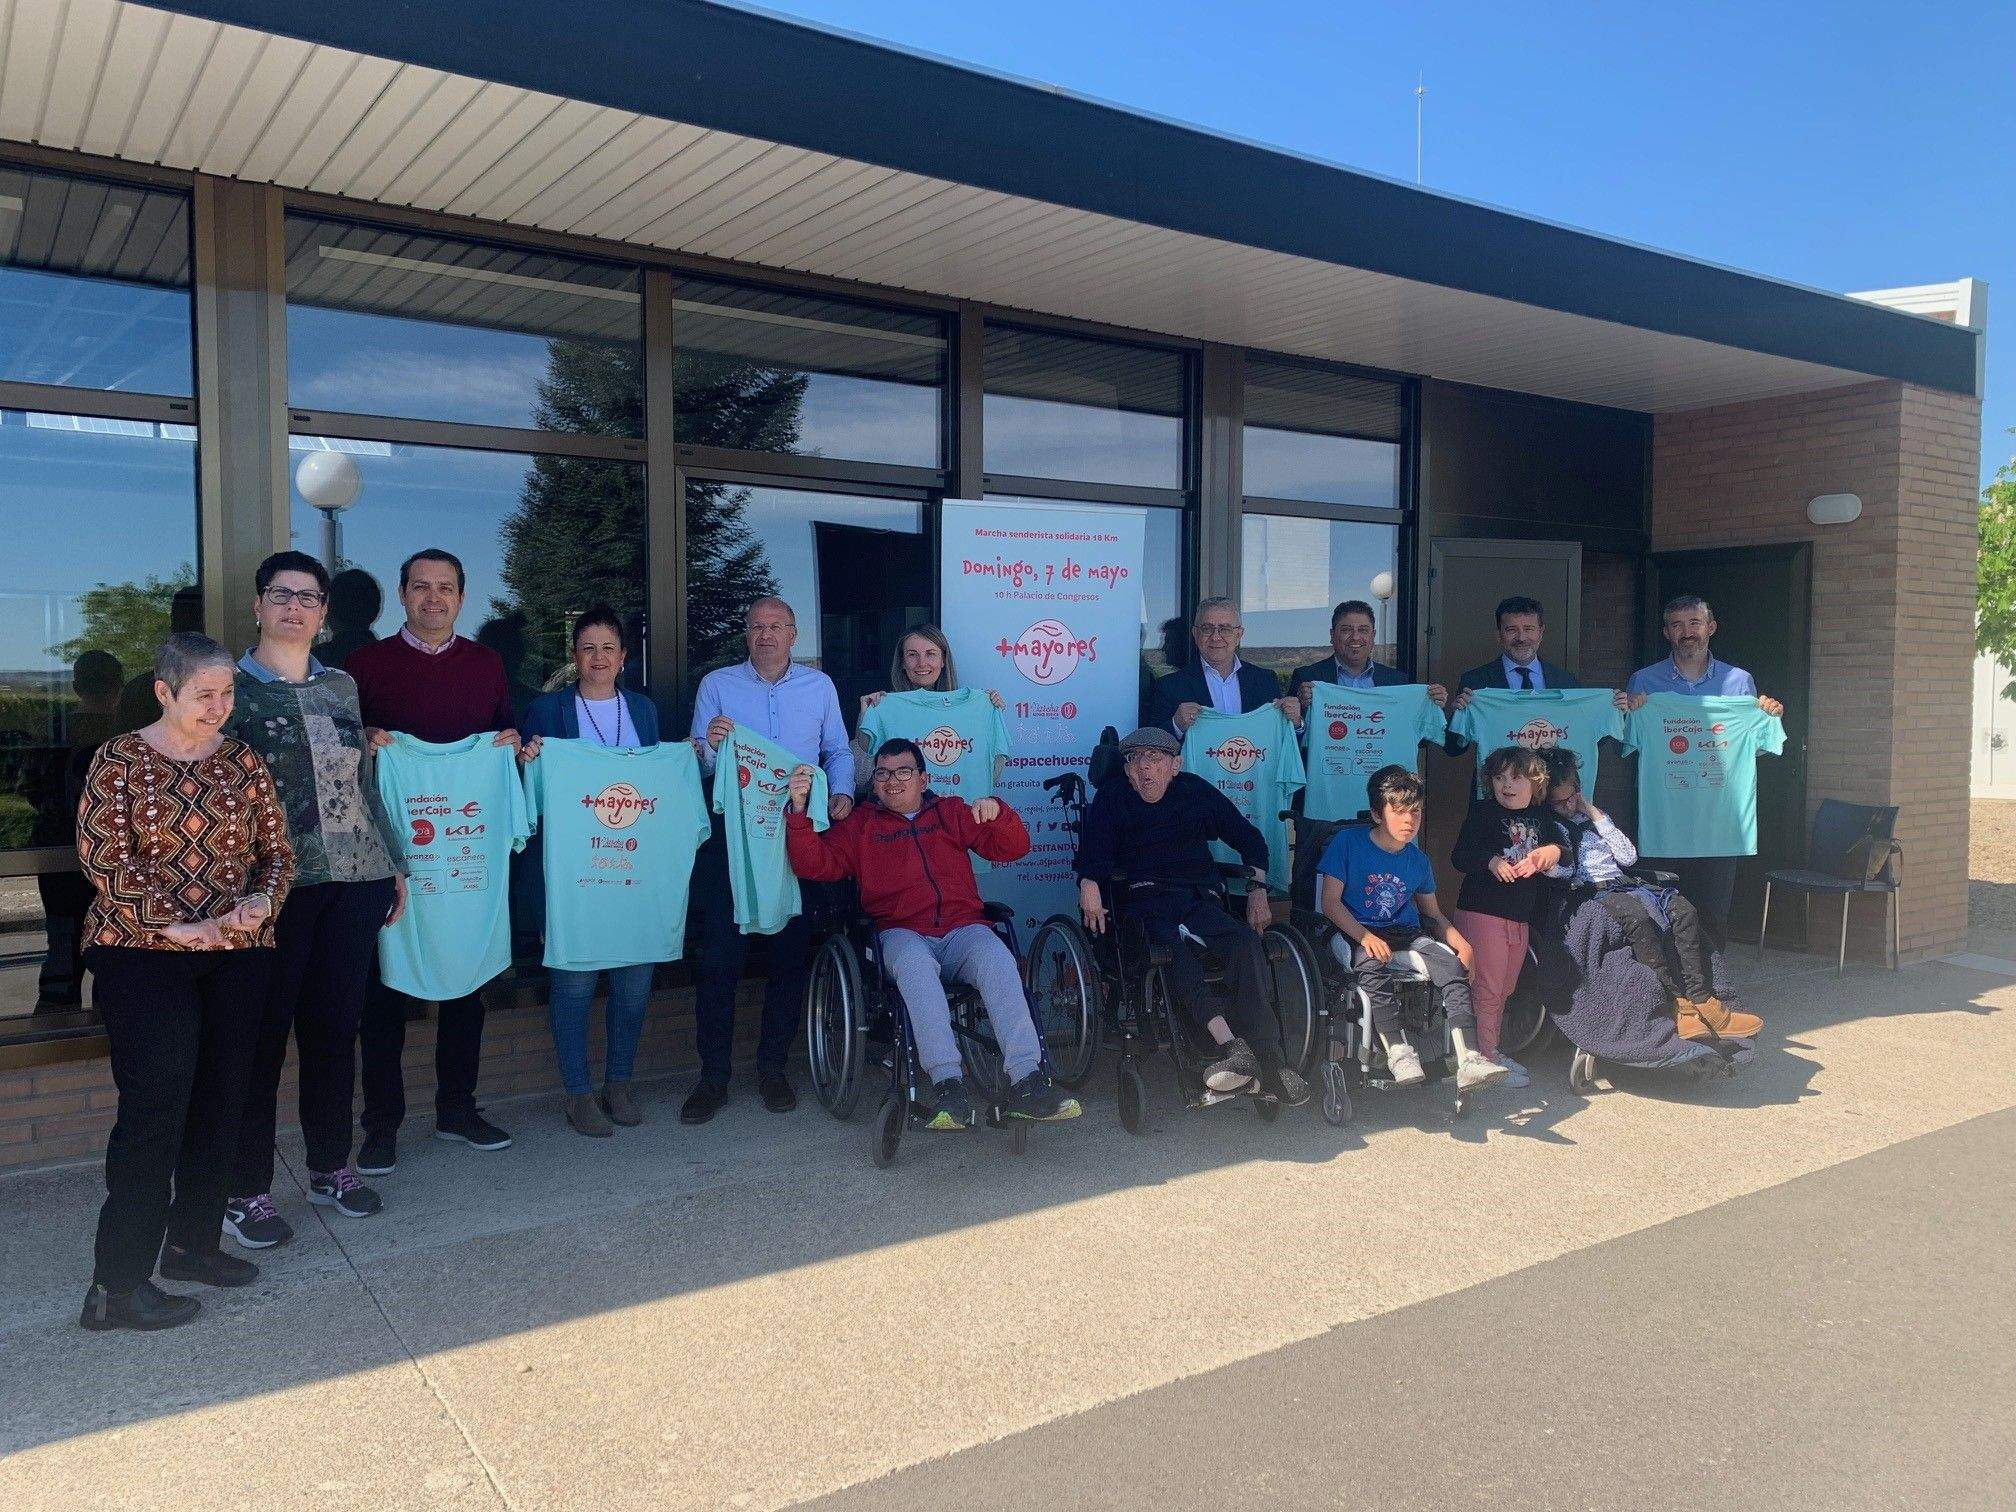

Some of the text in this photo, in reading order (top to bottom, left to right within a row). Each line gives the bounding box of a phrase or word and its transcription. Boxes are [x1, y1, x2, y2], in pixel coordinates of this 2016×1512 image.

[974, 528, 1007, 538] Marcha
[1009, 530, 1053, 540] senderista
[1055, 532, 1090, 541] solidaria
[963, 556, 1128, 589] Domingo, 7 de mayo
[1006, 591, 1012, 599] h
[1013, 592, 1043, 600] Palacio
[1045, 592, 1055, 600] de
[1057, 593, 1100, 602] Congresos
[1015, 702, 1029, 718] 11
[1005, 755, 1091, 769] aspacehuesc
[1008, 779, 1041, 789] gratuita
[405, 795, 448, 803] undación
[408, 806, 452, 818] erCaja
[591, 837, 600, 848] 11
